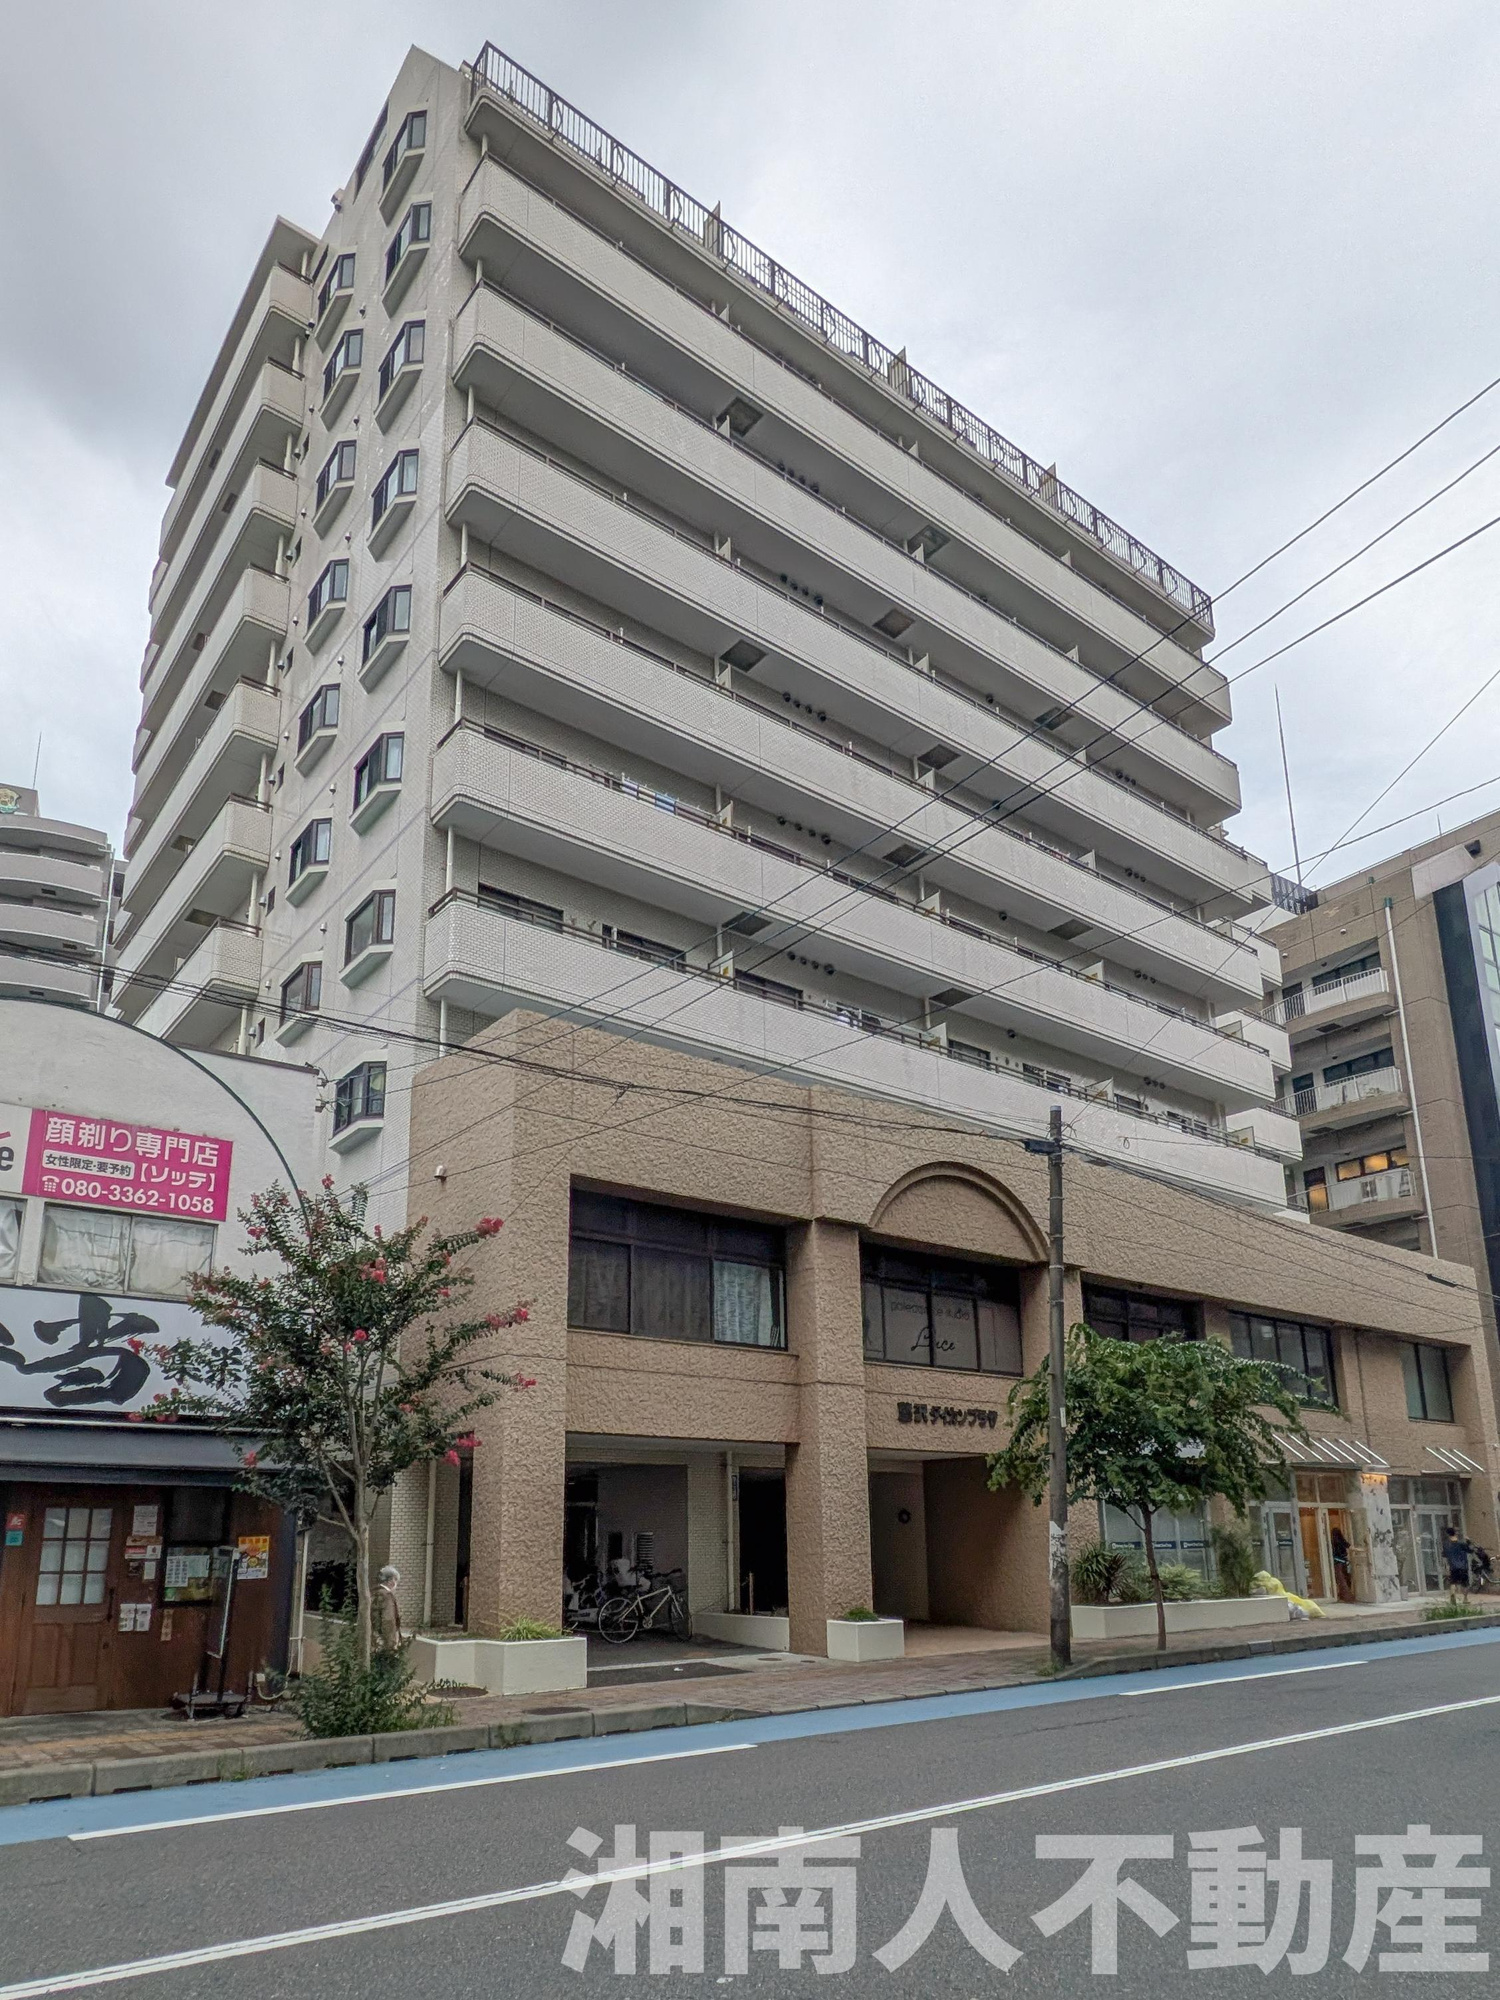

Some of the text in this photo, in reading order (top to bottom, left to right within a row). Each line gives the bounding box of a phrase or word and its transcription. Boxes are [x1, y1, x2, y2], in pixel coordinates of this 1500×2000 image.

[45, 1117, 219, 1167] 顔剃り専門店
[61, 1178, 214, 1213] 080-3362-1058
